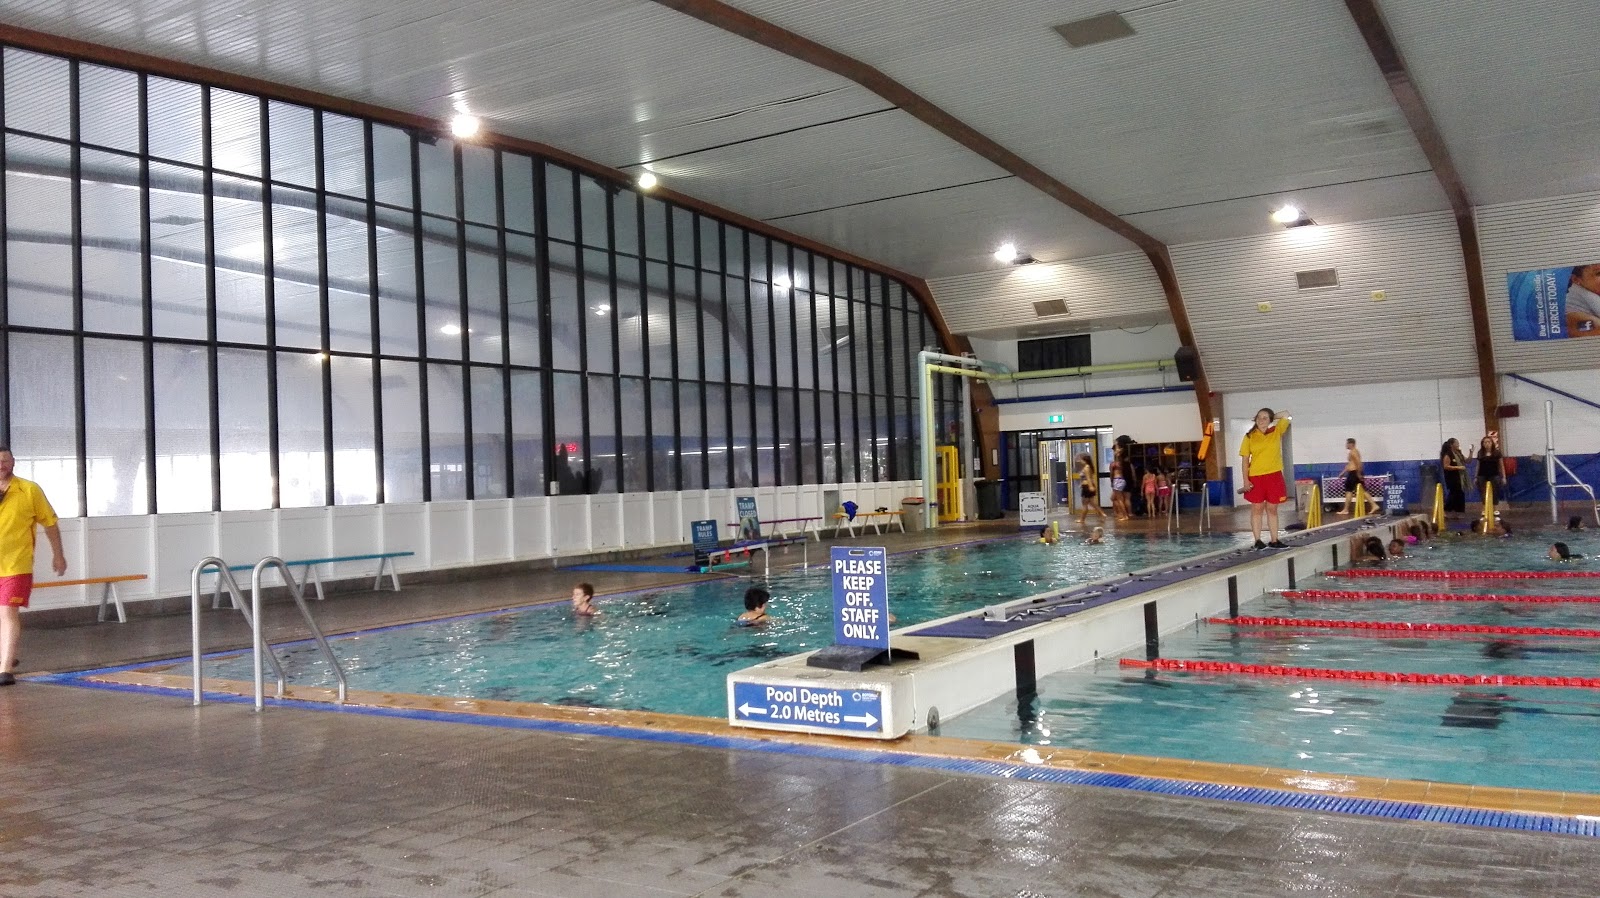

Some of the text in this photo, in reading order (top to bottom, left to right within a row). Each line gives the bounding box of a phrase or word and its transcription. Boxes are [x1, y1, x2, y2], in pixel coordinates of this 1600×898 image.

[1546, 273, 1560, 334] EXERCISE TODAY!
[740, 510, 757, 518] CLOSED
[835, 559, 882, 575] PLEASE
[842, 576, 875, 591] KEEP
[845, 592, 874, 607] OFF.
[841, 607, 879, 624] STAFF
[843, 624, 880, 640] ONLY.
[766, 686, 798, 703] Pool
[801, 688, 843, 708] Depth
[770, 704, 841, 724] 2.0 Metres
